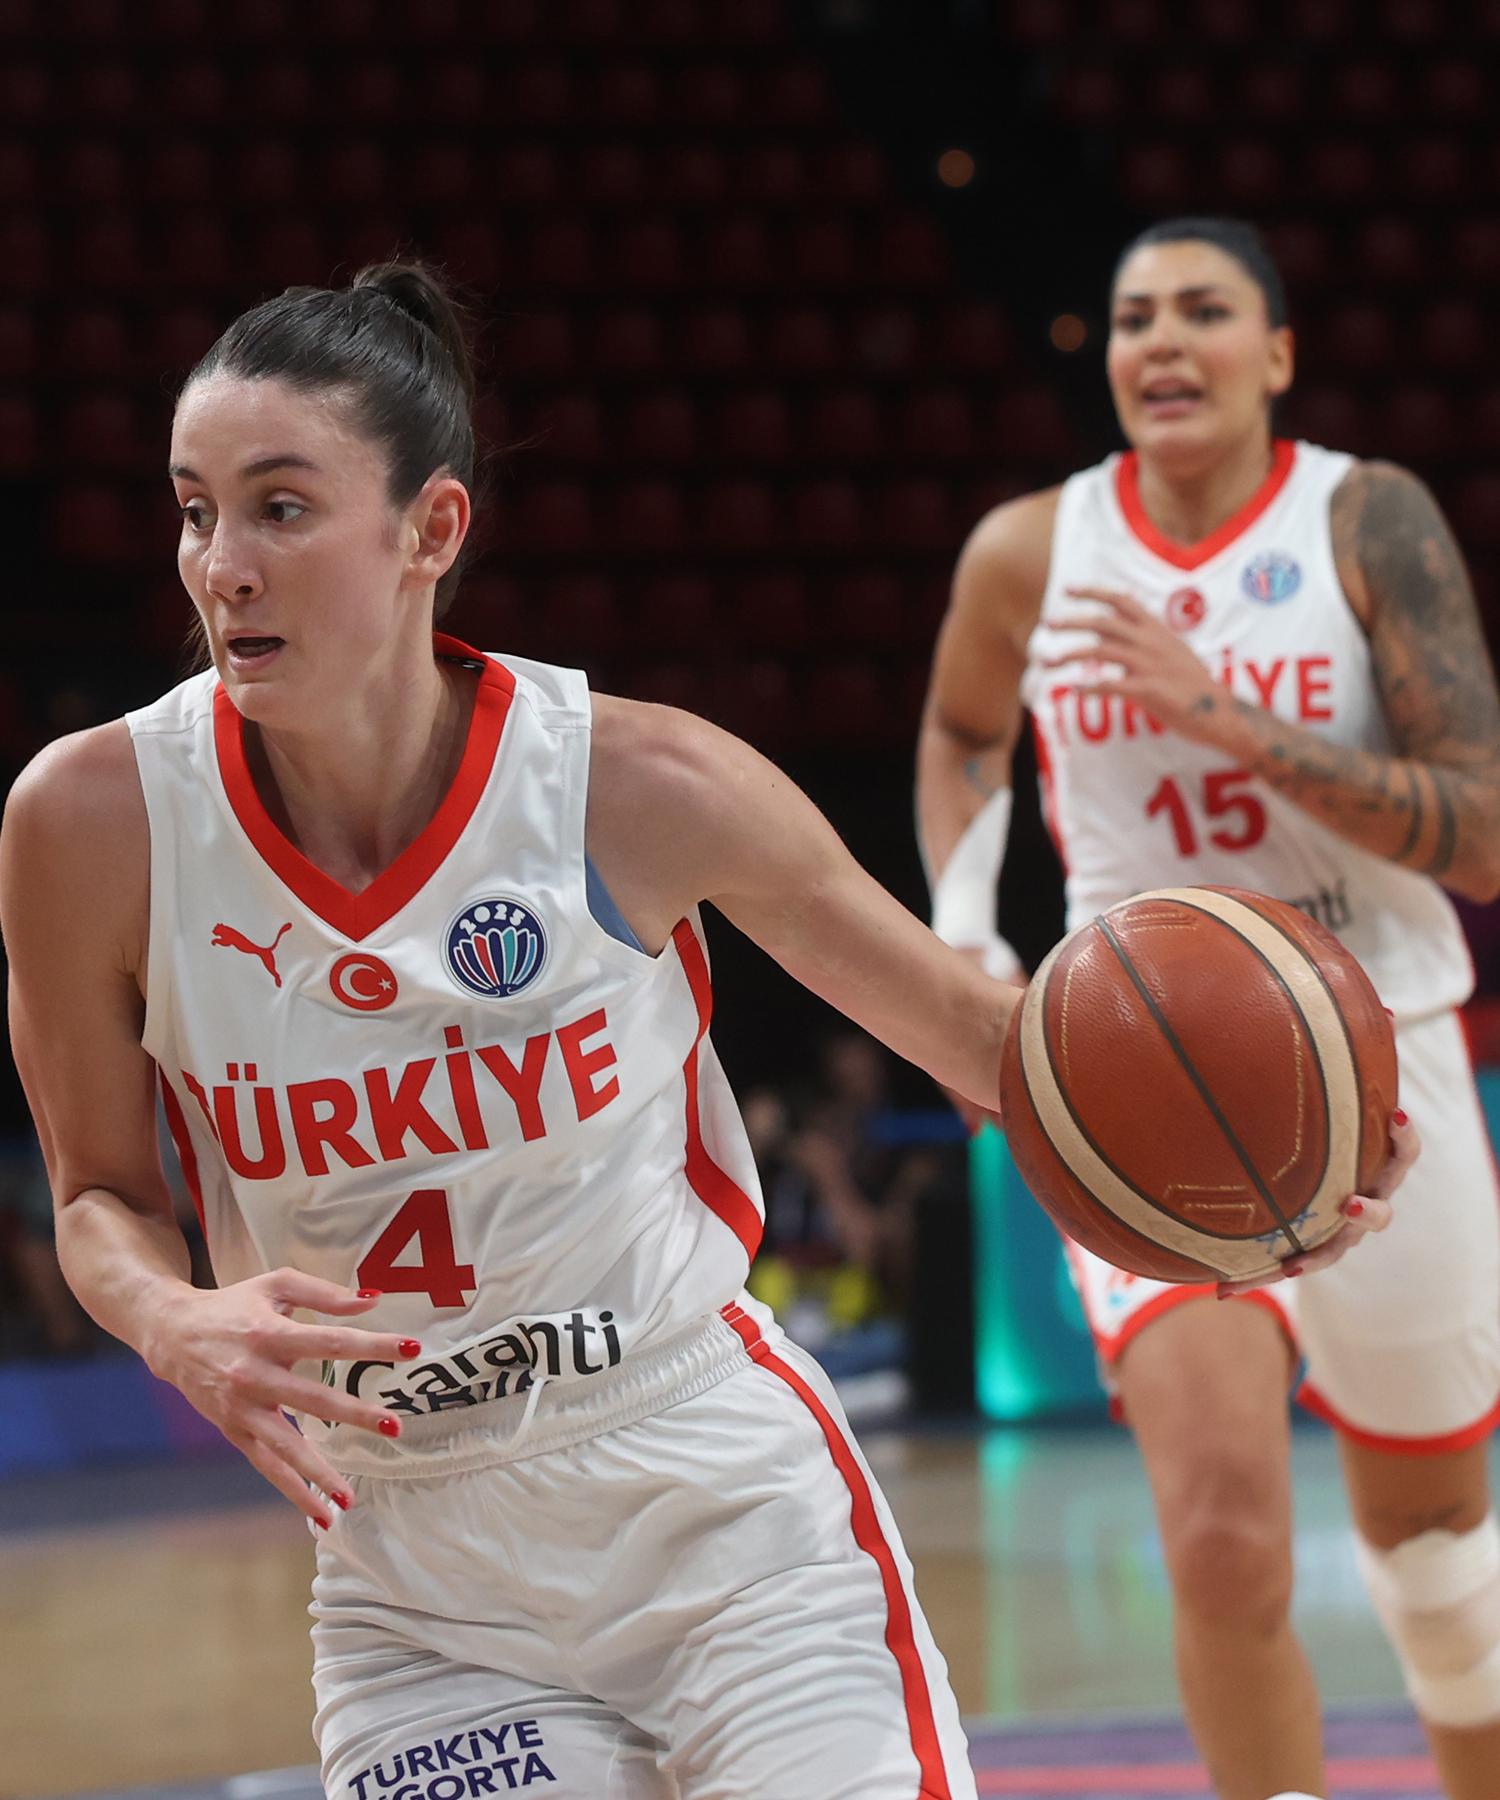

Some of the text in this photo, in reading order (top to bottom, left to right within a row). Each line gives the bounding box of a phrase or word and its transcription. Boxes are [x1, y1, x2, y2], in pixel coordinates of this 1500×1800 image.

[1146, 769, 1267, 858] 15
[459, 903, 526, 935] 2025
[357, 1189, 477, 1308] 4
[346, 1310, 621, 1403] Garanti
